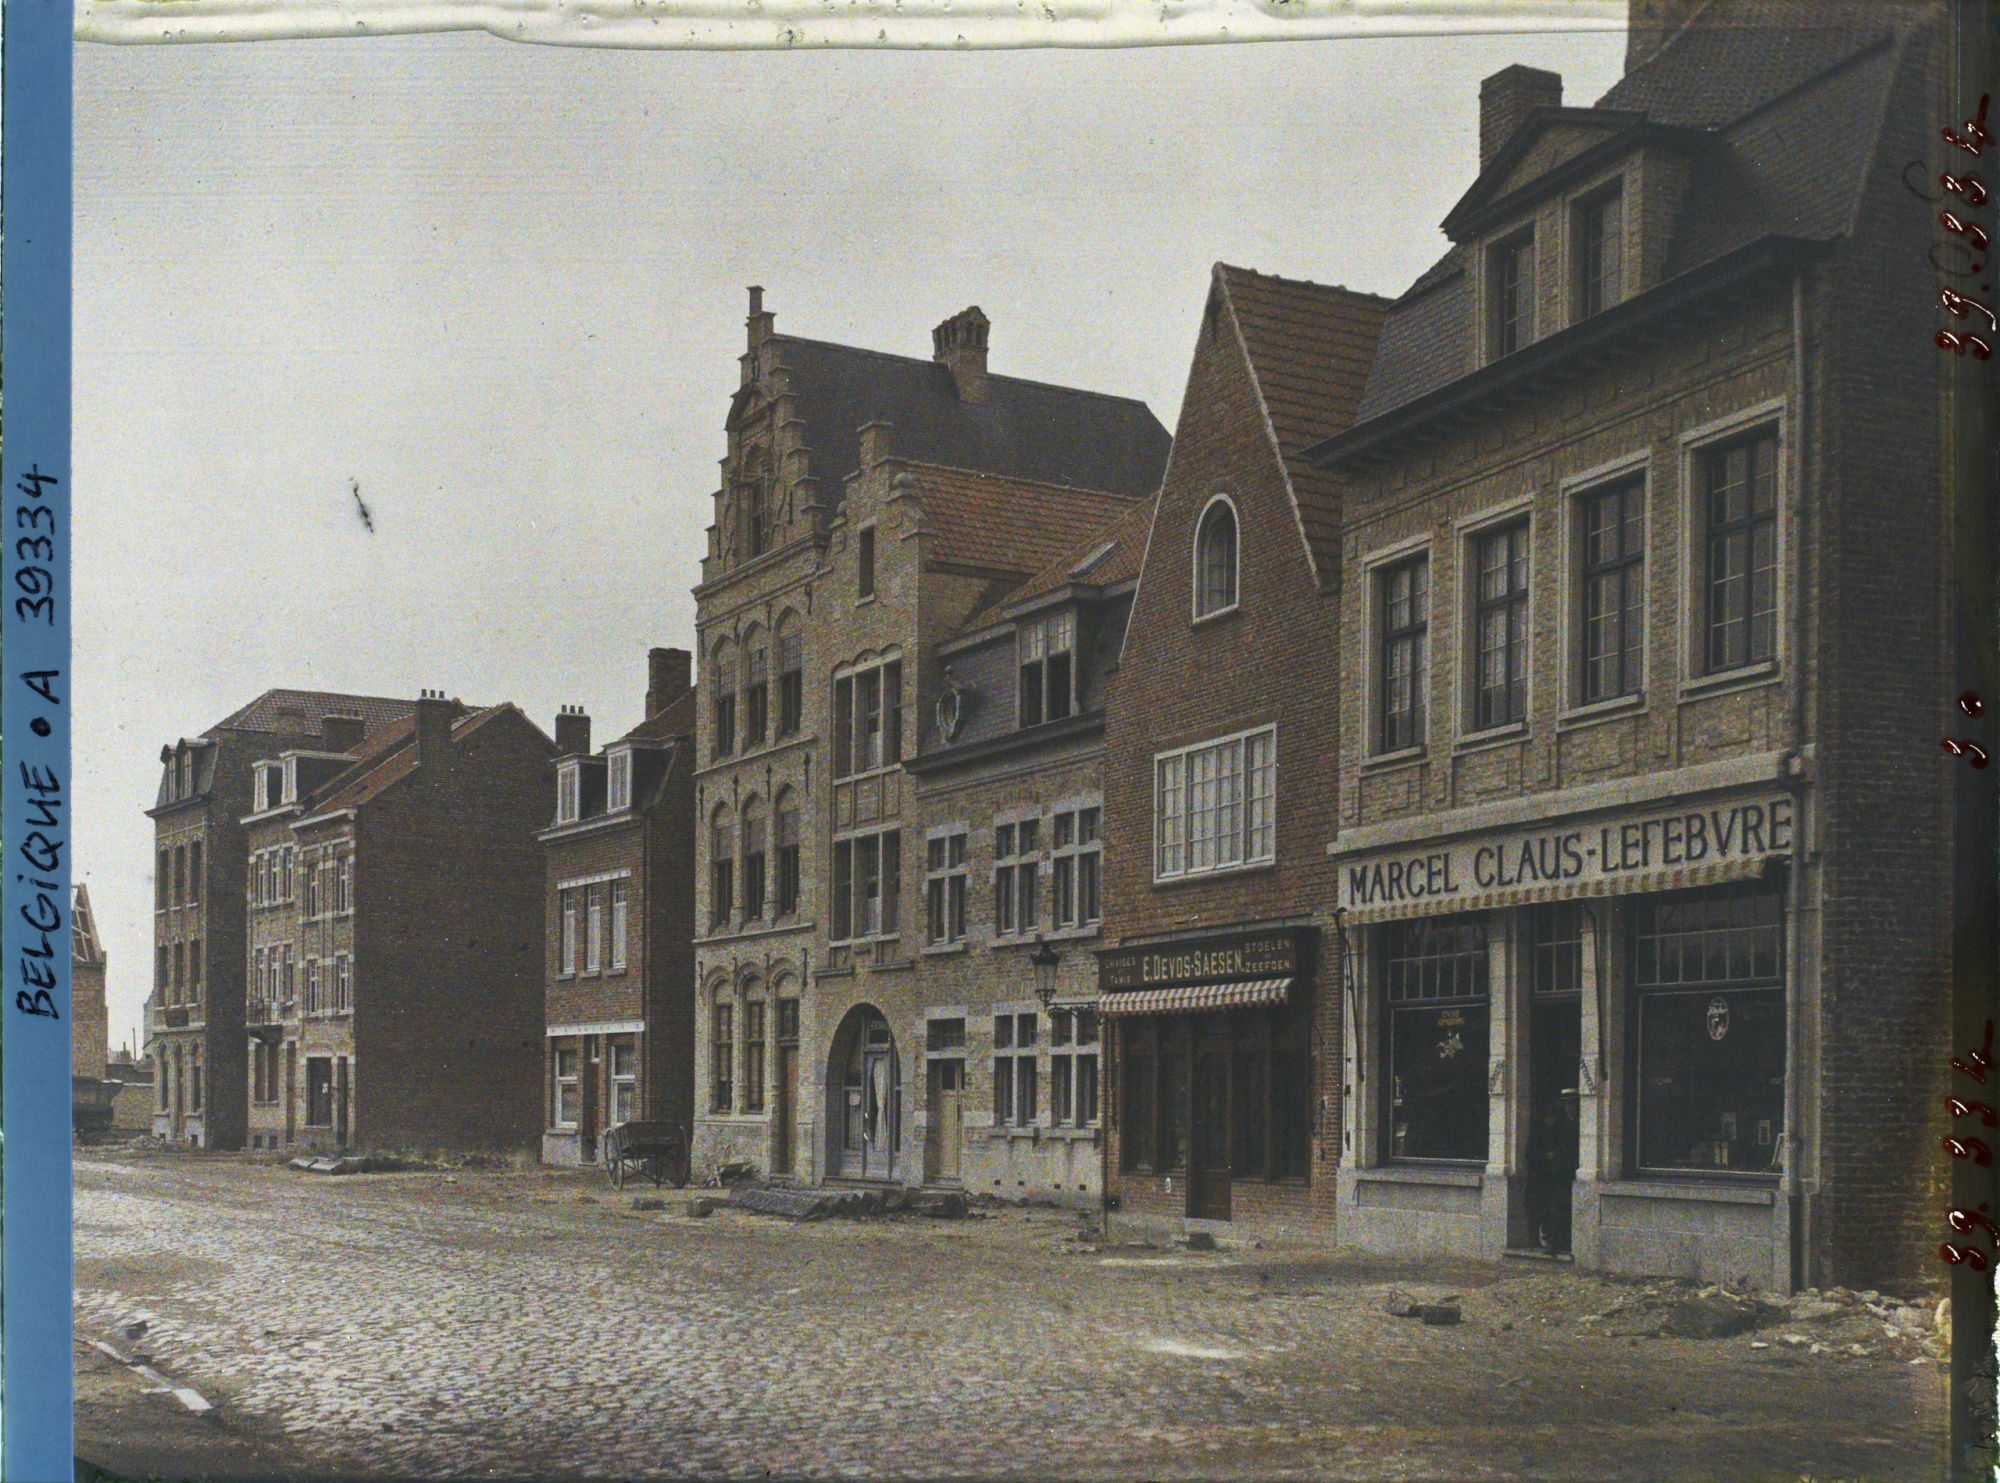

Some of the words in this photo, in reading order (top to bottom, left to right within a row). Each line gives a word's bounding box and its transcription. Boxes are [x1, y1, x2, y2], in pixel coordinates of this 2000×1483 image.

[15, 463, 58, 627] 39334
[23, 670, 60, 704] A
[1350, 853, 1459, 906] MARCEL
[1474, 800, 1793, 888] CLAUS-LEFEBVRE
